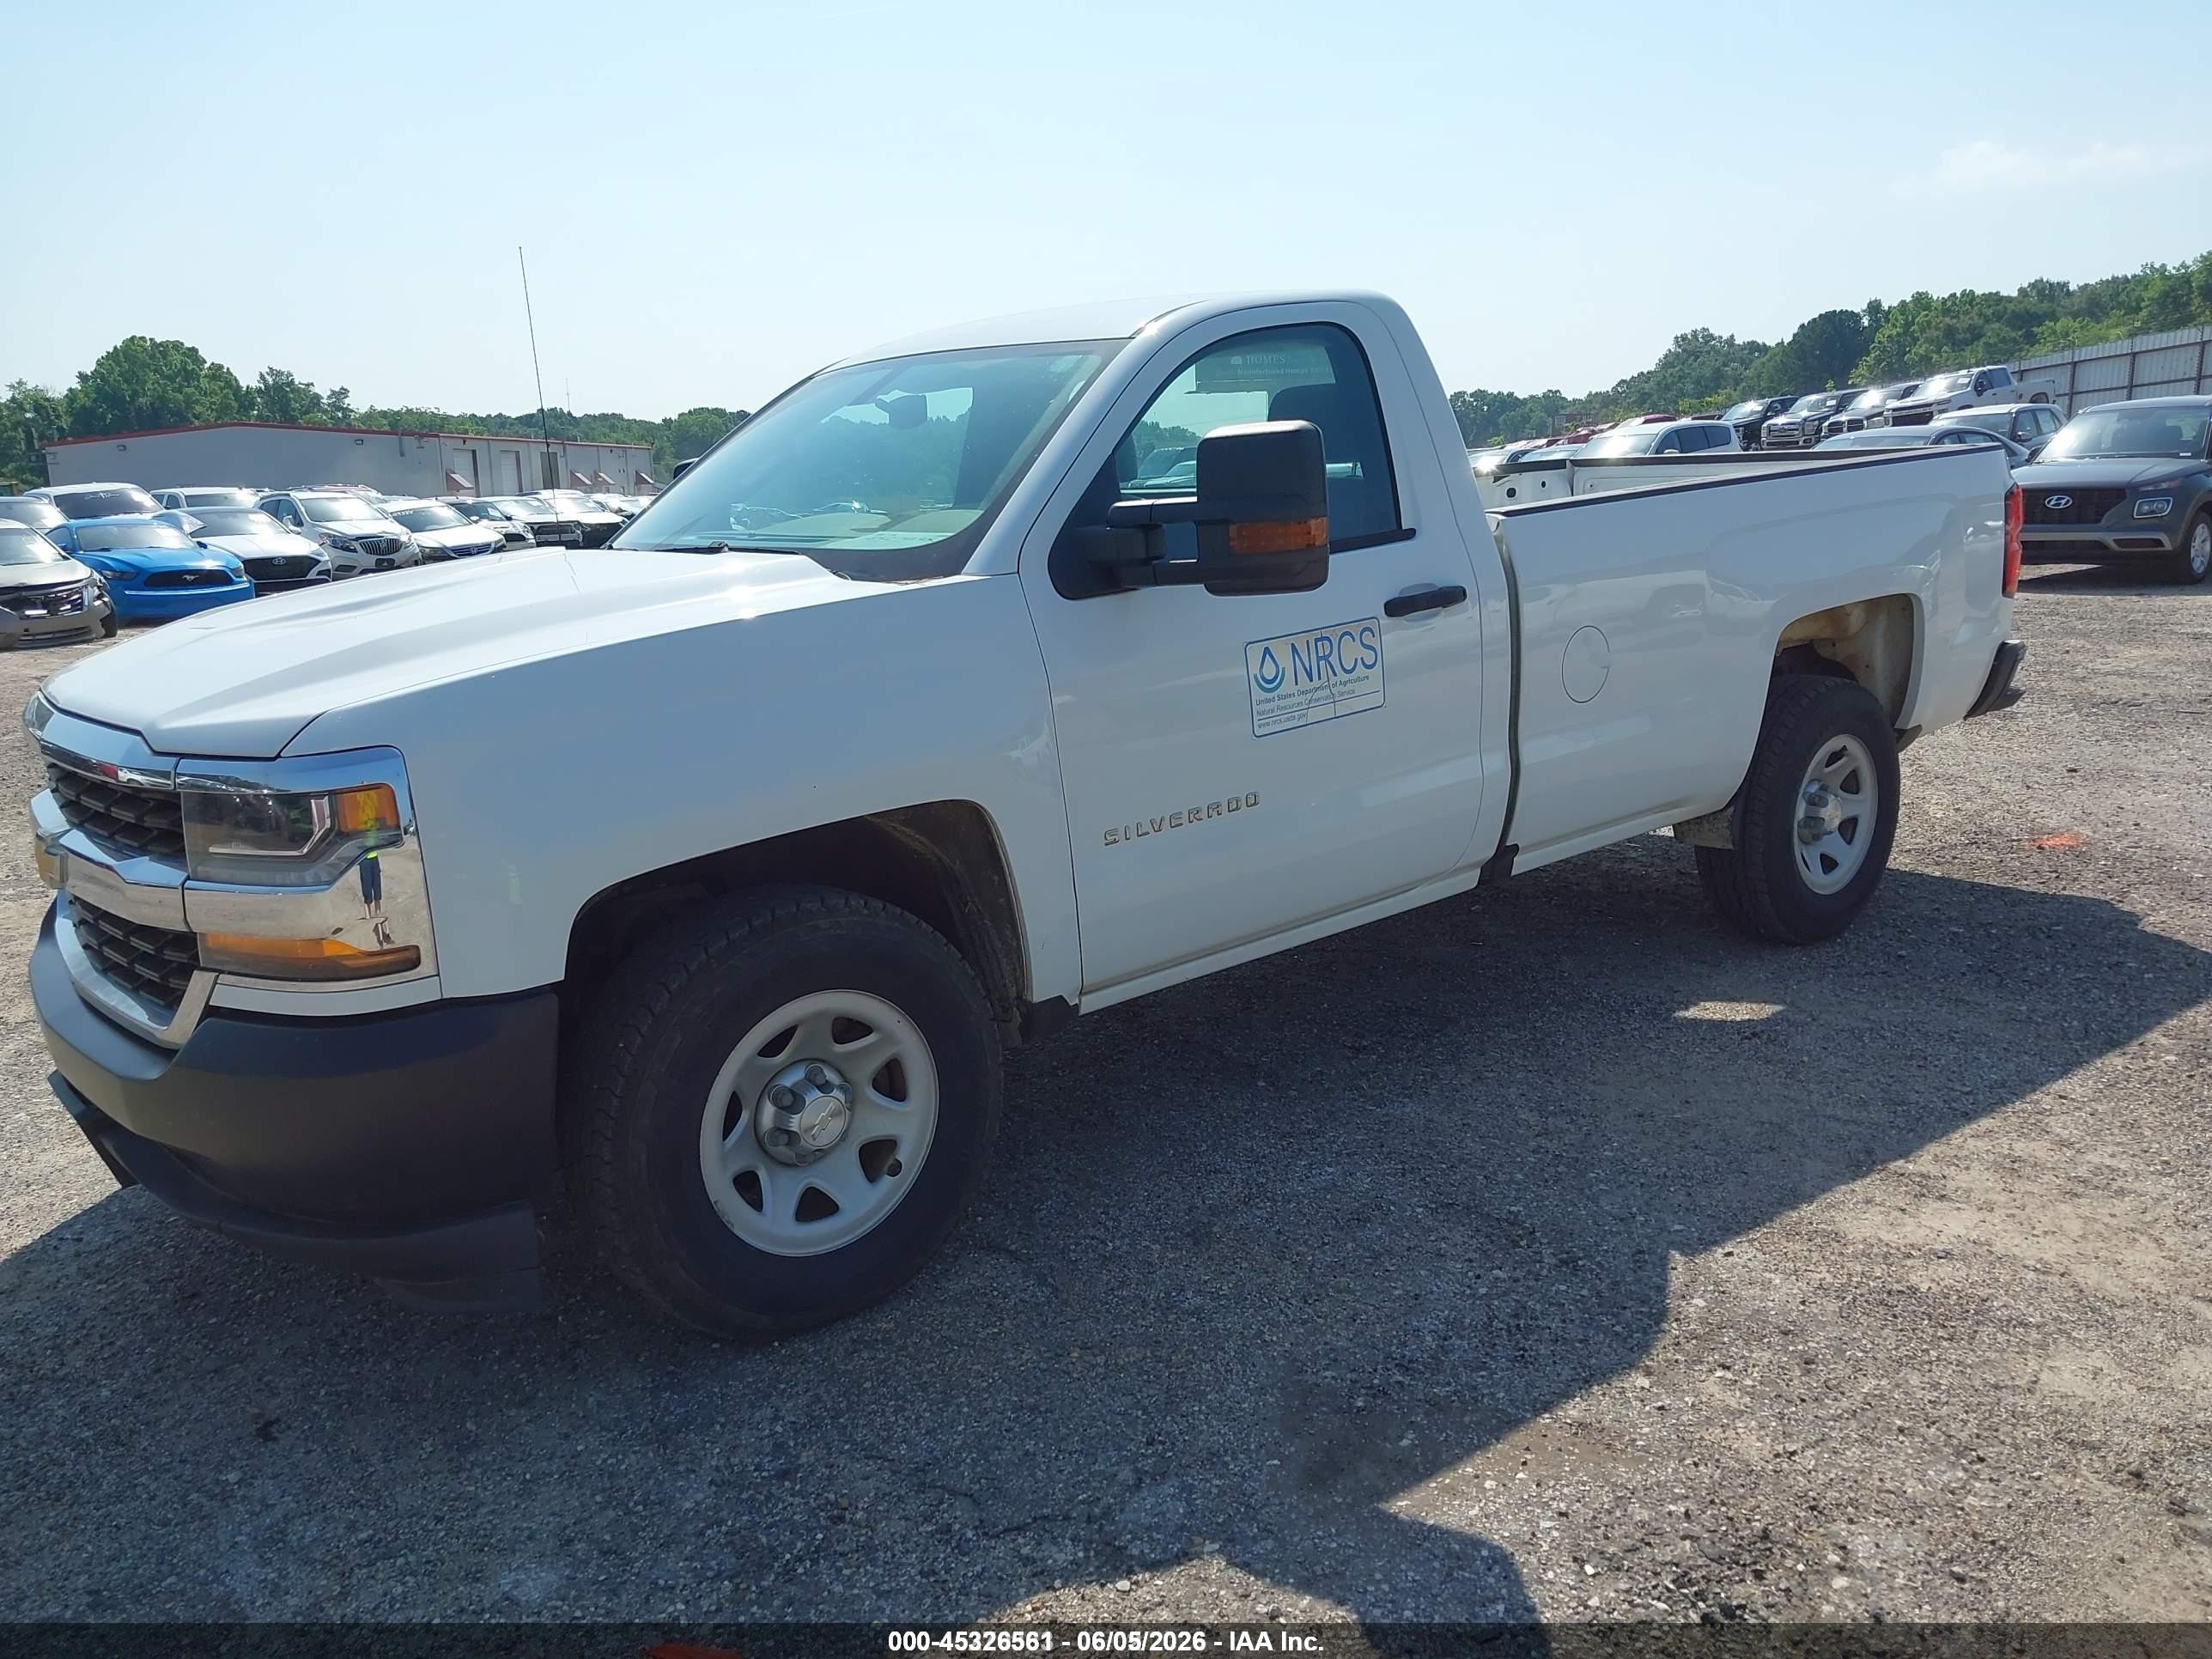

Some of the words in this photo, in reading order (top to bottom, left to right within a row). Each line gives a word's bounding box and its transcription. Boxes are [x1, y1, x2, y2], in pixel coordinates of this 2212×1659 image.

[1291, 626, 1378, 686] NRCS
[1255, 696, 1276, 706] United
[1277, 691, 1296, 702] States
[1339, 674, 1370, 687] Agriculture
[1256, 706, 1275, 716] Natural
[1277, 701, 1304, 712] Resources
[1104, 792, 1260, 846] SILVERADO
